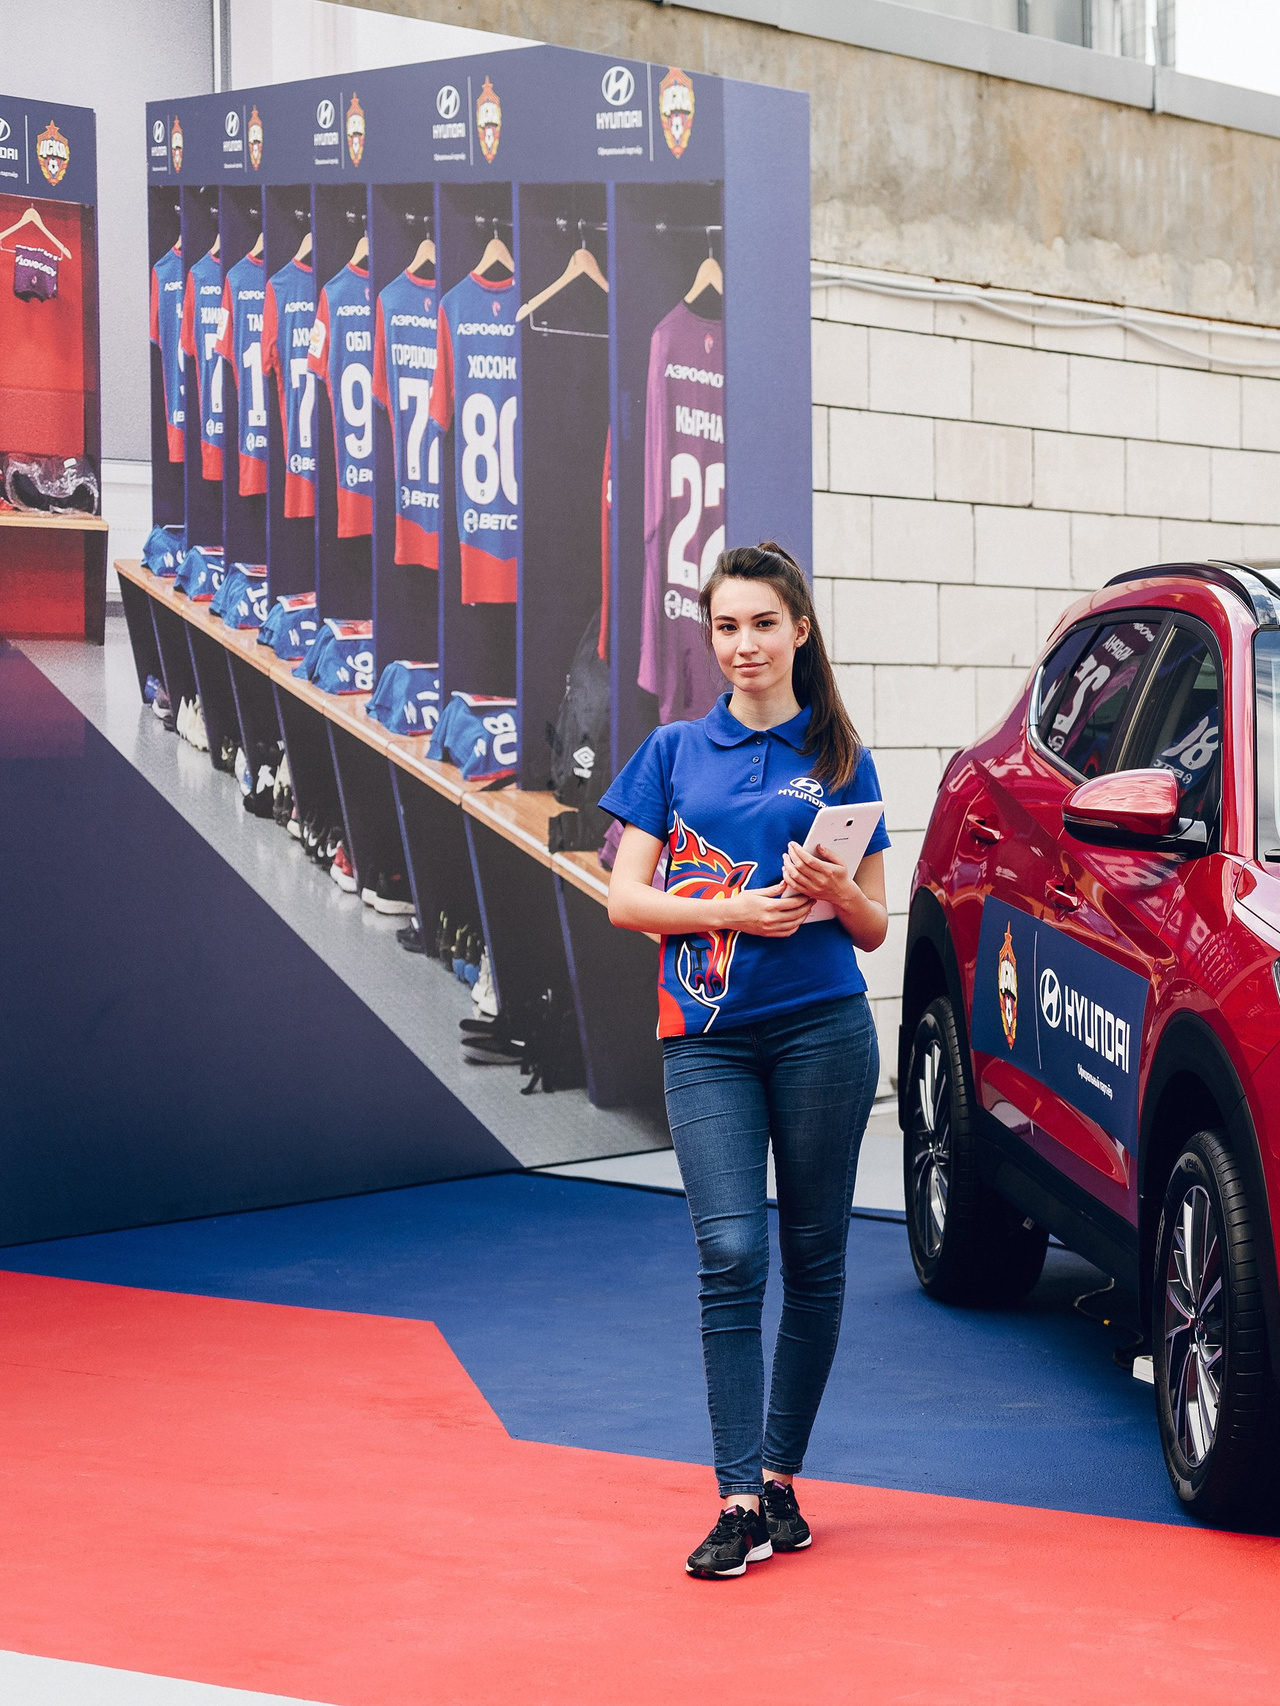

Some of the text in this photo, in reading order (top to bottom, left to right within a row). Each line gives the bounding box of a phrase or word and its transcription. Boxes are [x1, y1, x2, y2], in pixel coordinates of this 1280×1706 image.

[596, 110, 643, 130] HYUNDAI
[433, 122, 466, 139] HYUNDAI
[39, 139, 67, 159] ЦСКА
[457, 322, 516, 337] АЭРОФЛО
[664, 363, 724, 388] АЭРОФЛО
[341, 363, 372, 459] 9
[778, 789, 828, 809] HYUNDA
[1065, 985, 1130, 1074] HYUNDAI
